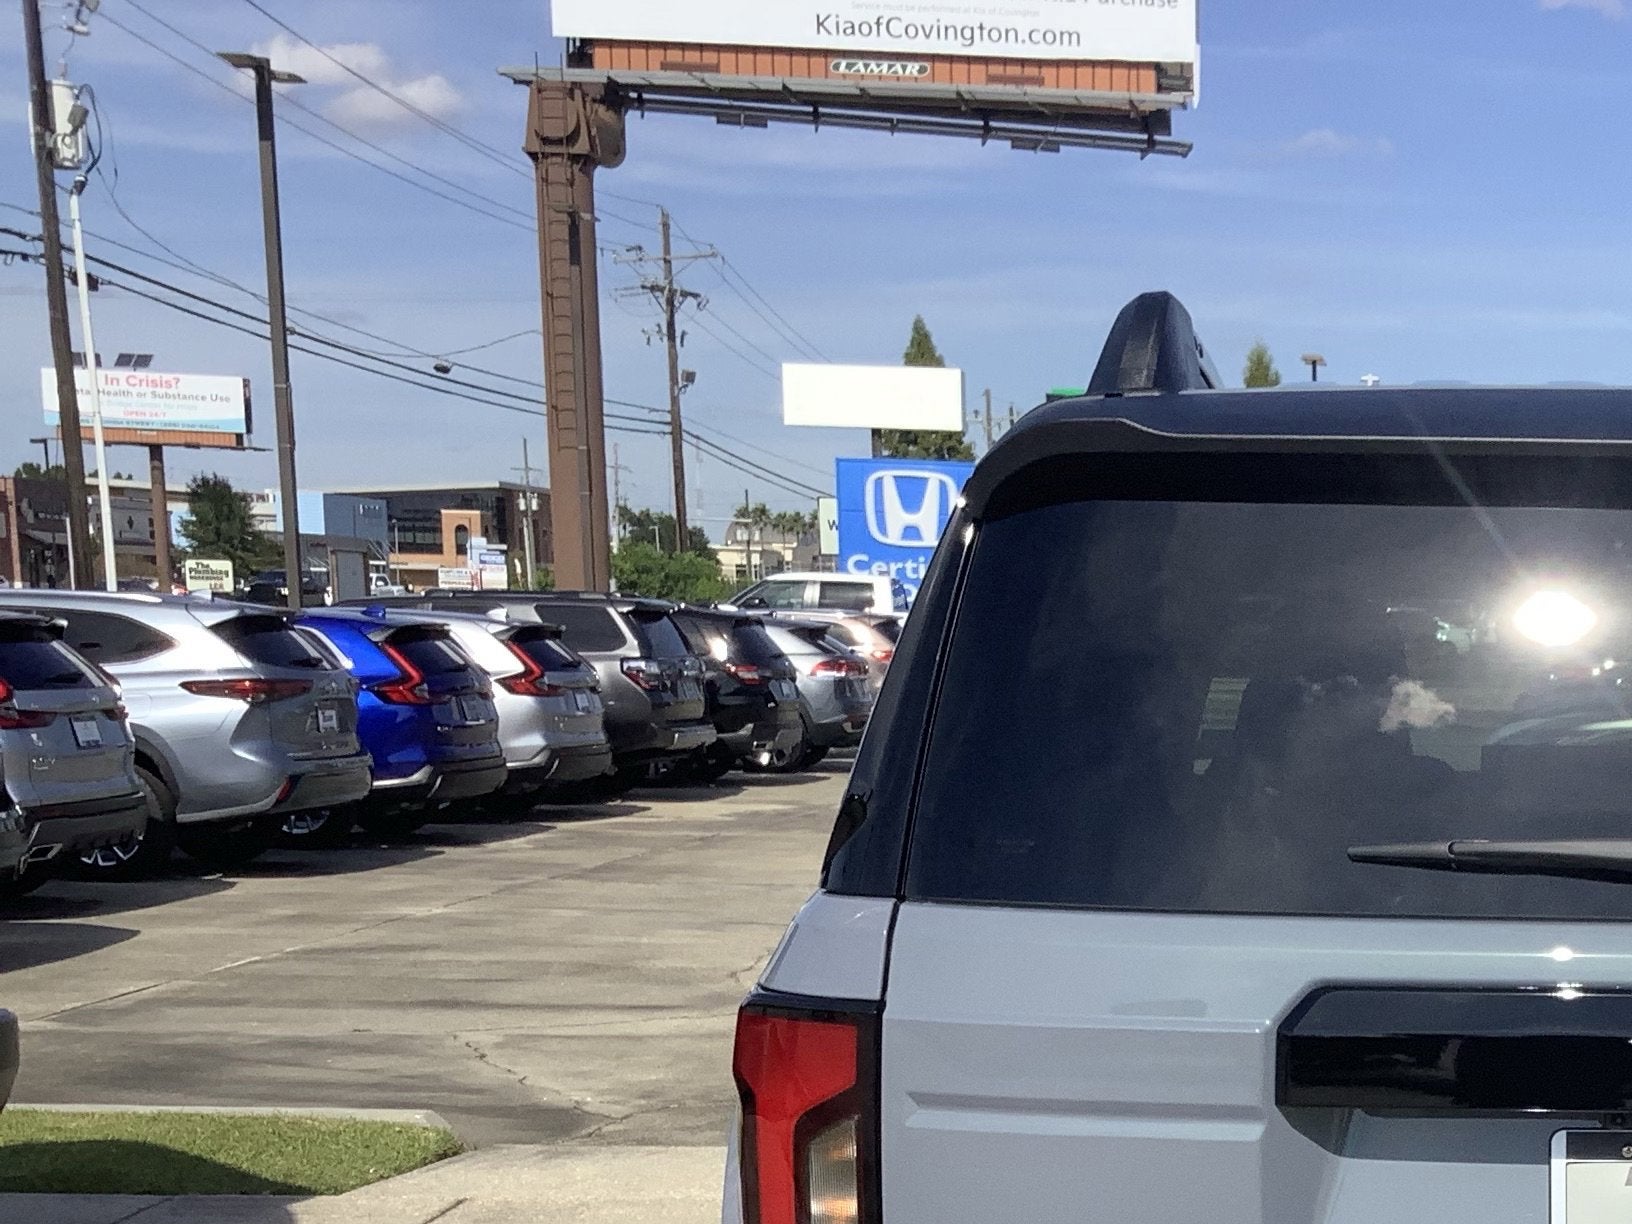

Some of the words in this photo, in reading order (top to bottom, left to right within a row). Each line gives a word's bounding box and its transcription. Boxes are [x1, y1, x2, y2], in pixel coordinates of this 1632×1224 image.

[816, 13, 1081, 47] KiaofCovington.com
[837, 60, 920, 76] LAMAR
[104, 374, 120, 387] In
[126, 375, 181, 389] Crisis?
[98, 389, 133, 398] Health
[136, 391, 147, 399] or
[150, 390, 208, 402] Substance
[210, 394, 231, 404] Use
[188, 567, 230, 578] Plumbing
